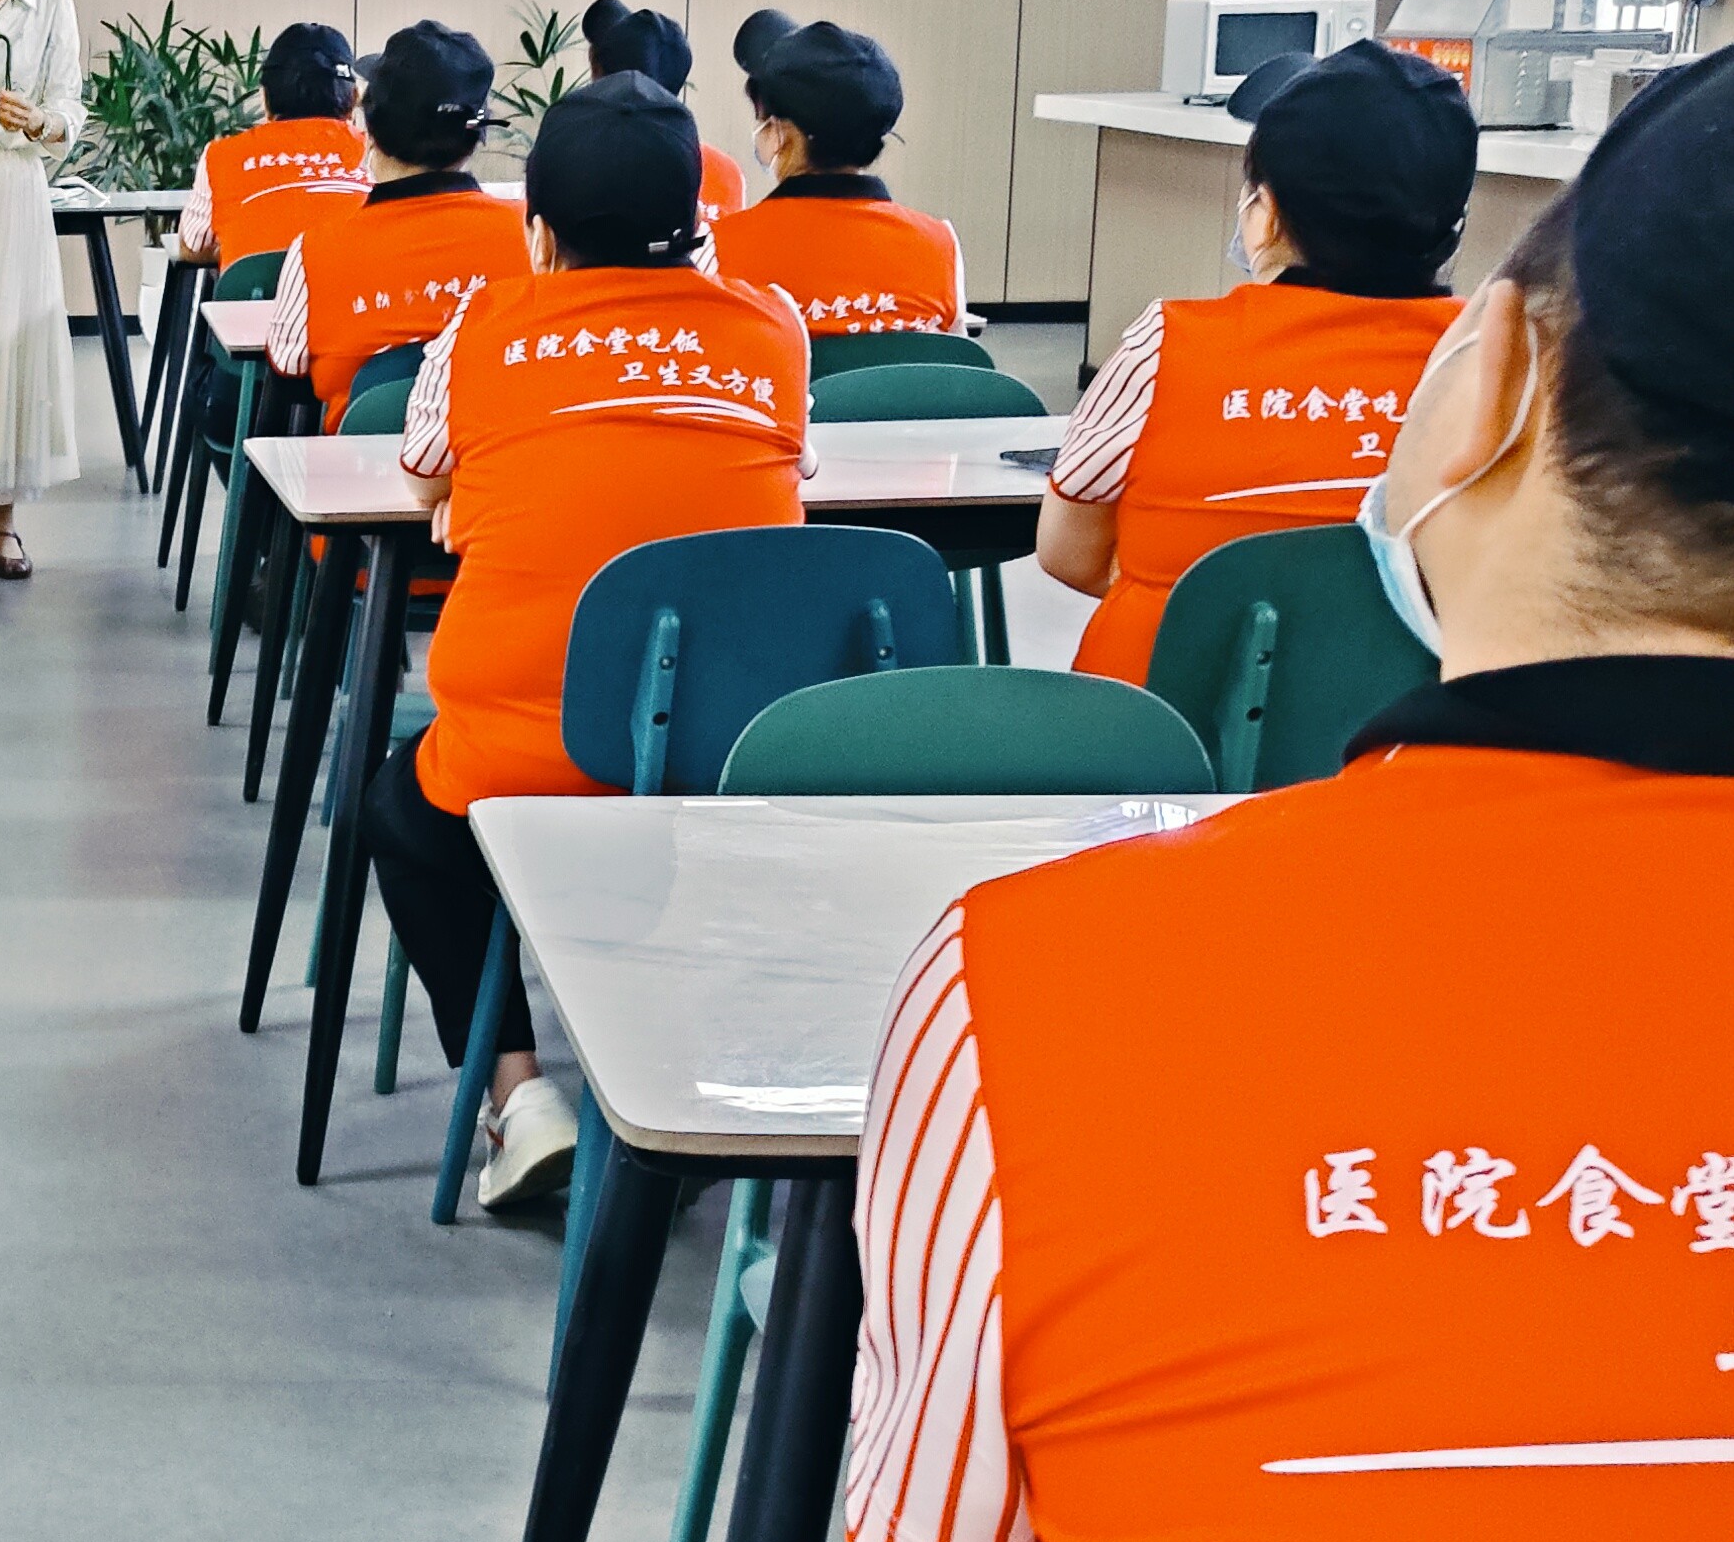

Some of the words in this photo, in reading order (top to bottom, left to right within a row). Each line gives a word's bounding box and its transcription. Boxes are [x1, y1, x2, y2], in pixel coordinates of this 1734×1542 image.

[299, 166, 370, 180] 卫生又方
[797, 292, 899, 321] 食堂吃饭
[504, 327, 704, 366] 医院食堂吃饭
[618, 359, 776, 410] 卫生又方便
[1351, 431, 1387, 460] 卫
